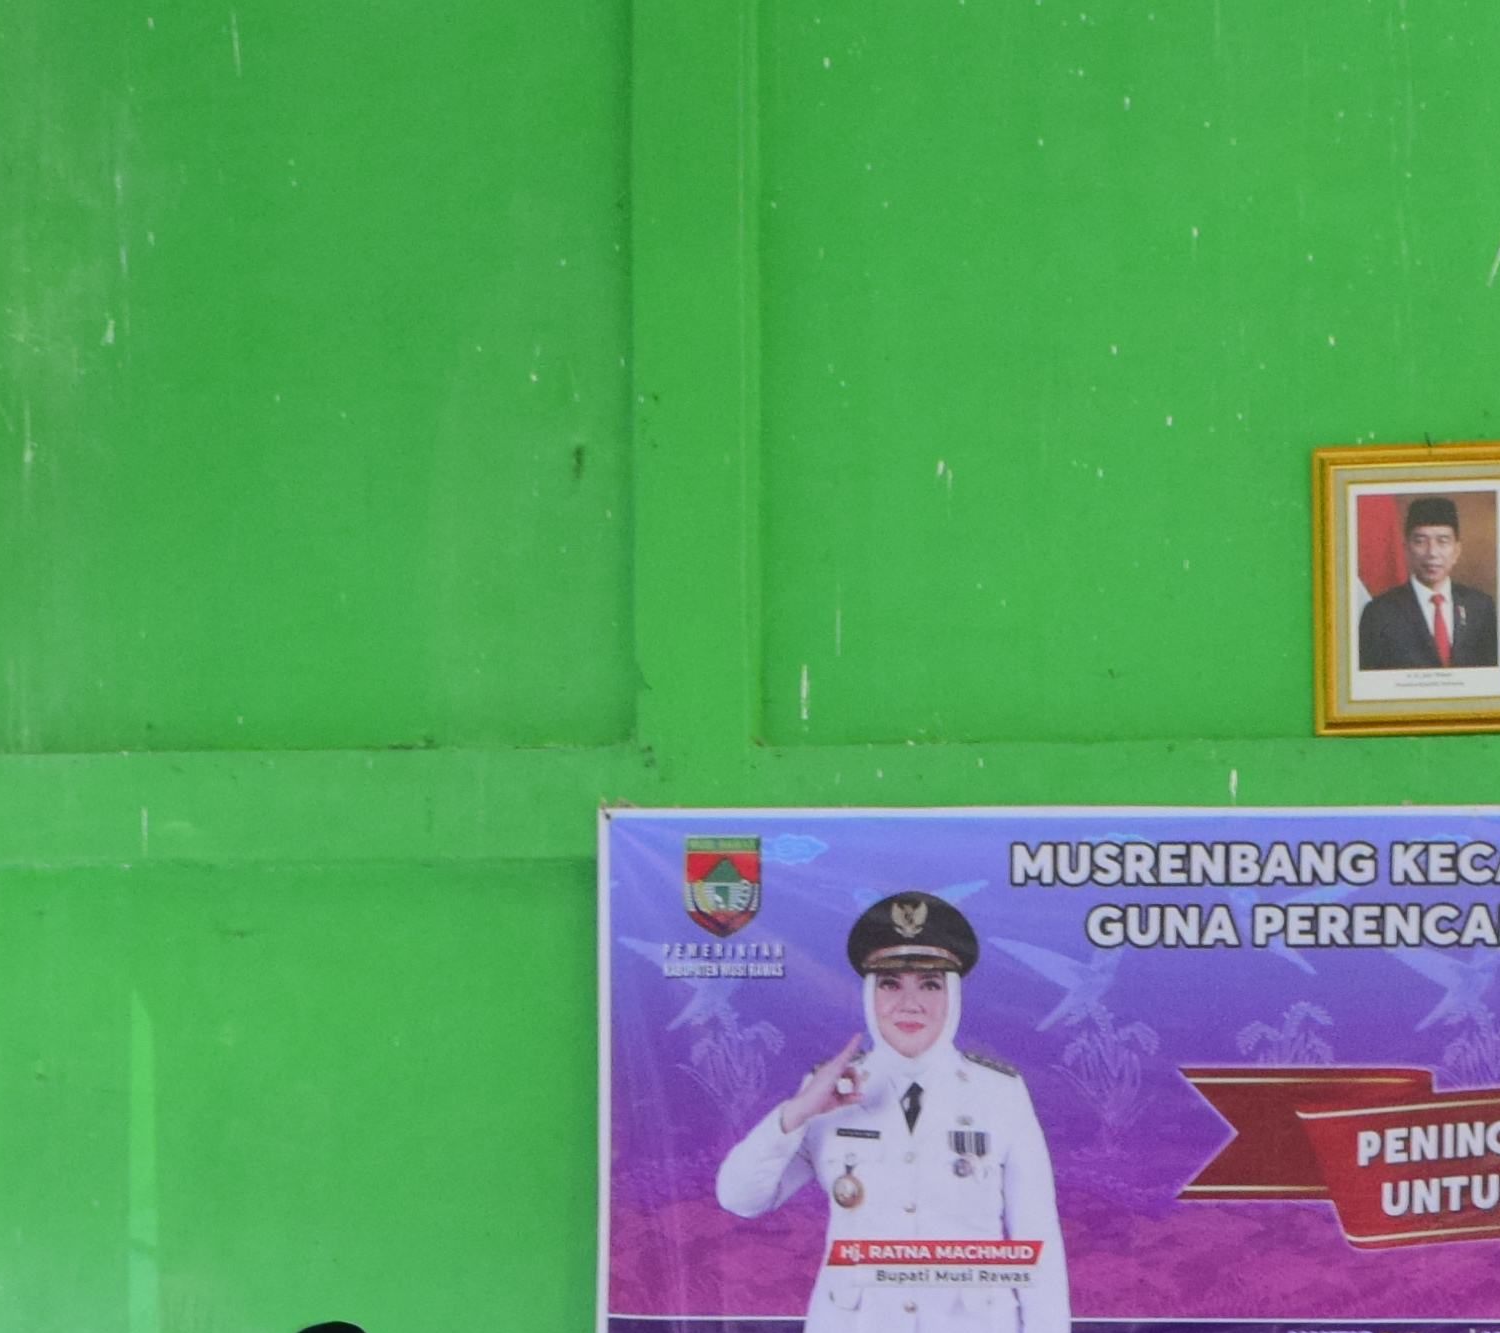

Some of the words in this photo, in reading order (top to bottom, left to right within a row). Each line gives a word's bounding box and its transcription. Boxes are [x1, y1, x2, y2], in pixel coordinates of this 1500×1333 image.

[1010, 841, 1377, 886] MUSRENBANG
[1086, 903, 1241, 948] GUNA
[662, 943, 785, 959] PEMERINTAH
[840, 1243, 865, 1262] Hj.
[868, 1244, 931, 1260] RATNA
[934, 1244, 1035, 1260] MACHMUD
[876, 1268, 931, 1284] Bupati
[935, 1268, 974, 1282] Musi
[979, 1269, 1031, 1283] Rawas
